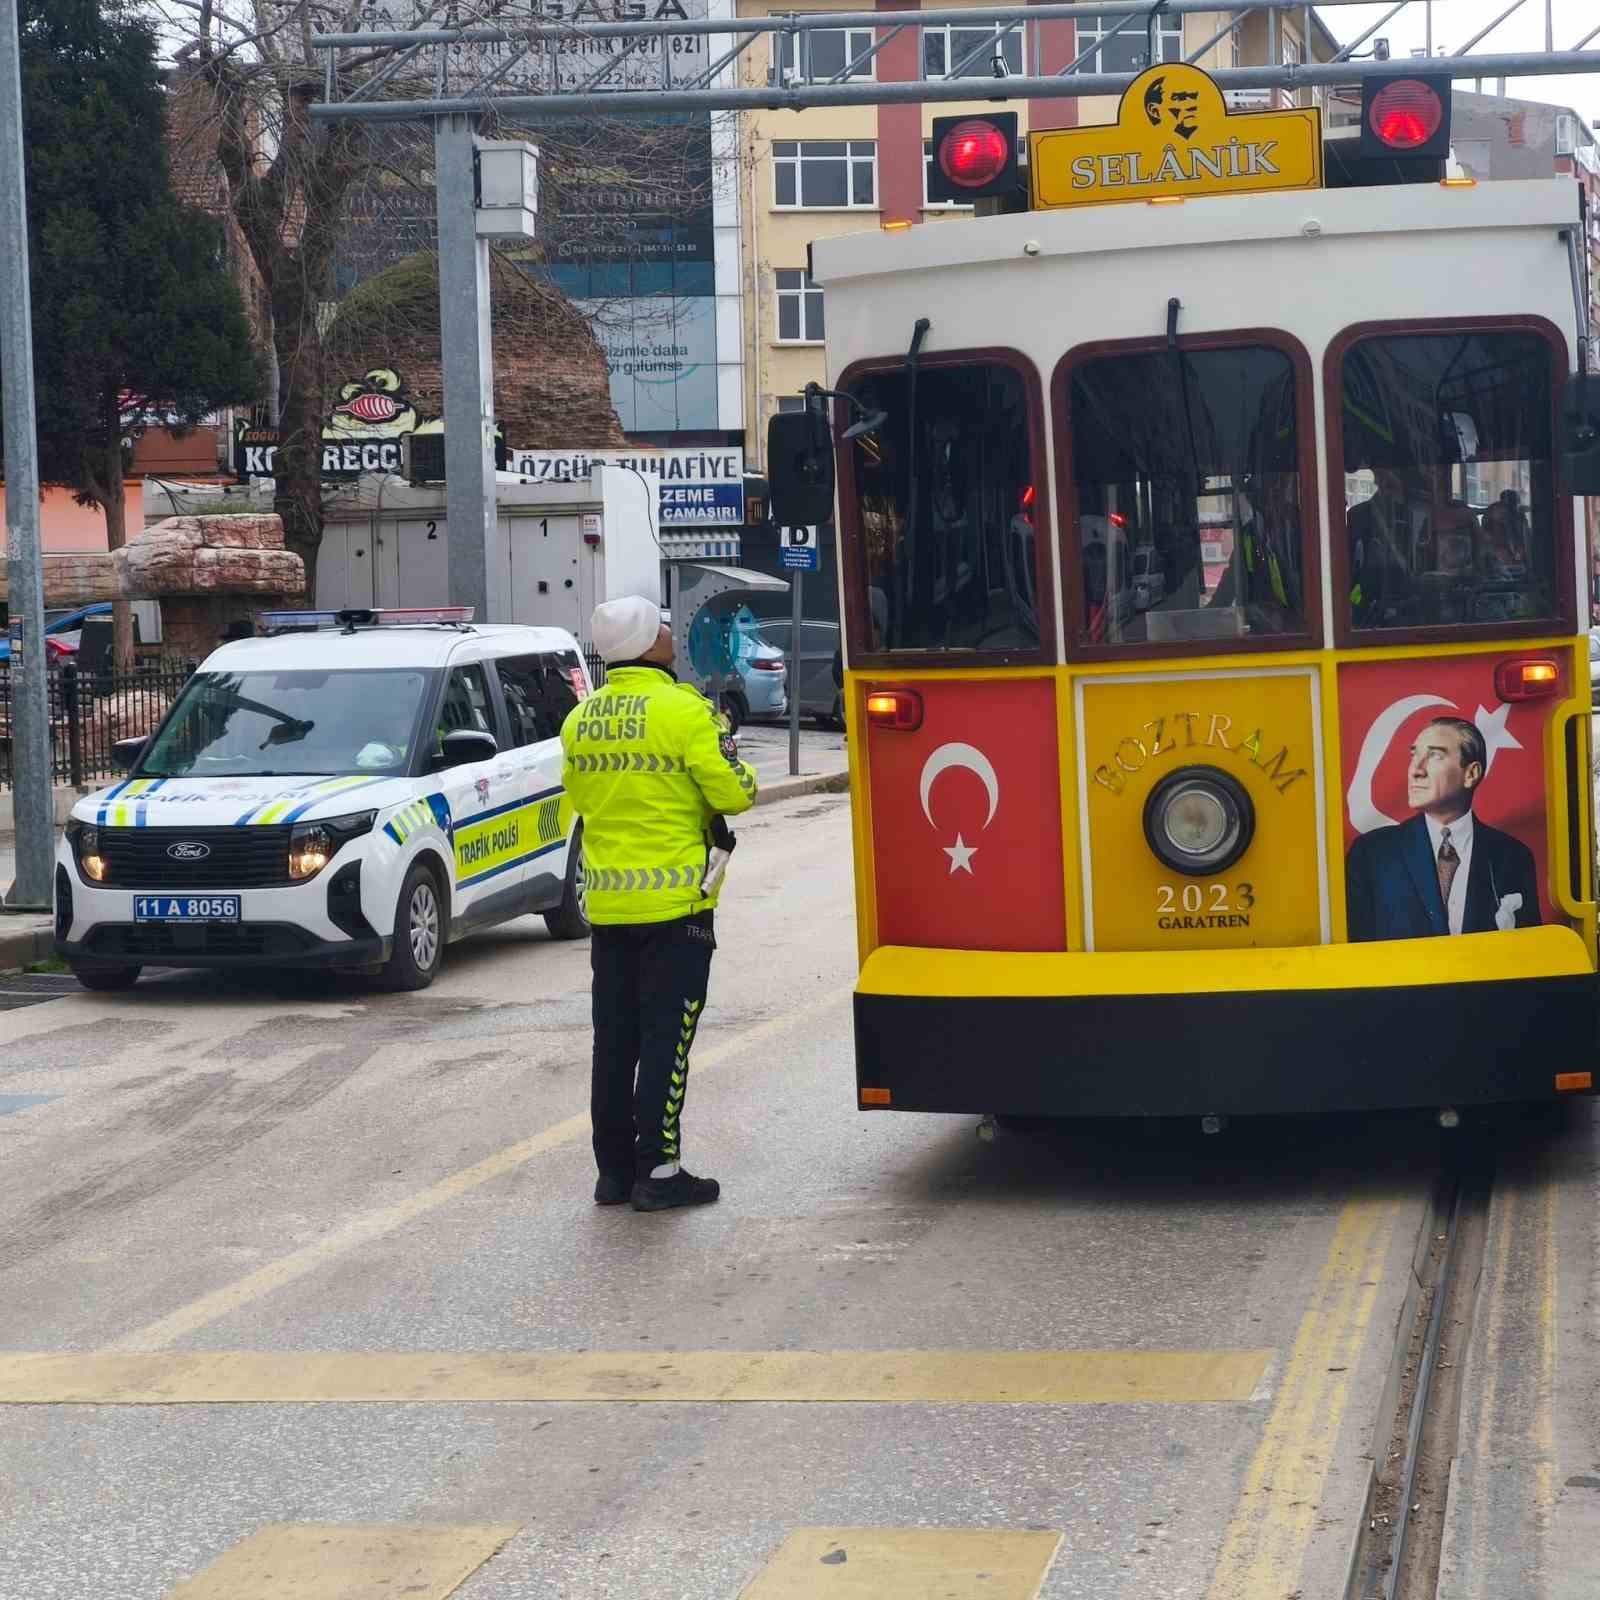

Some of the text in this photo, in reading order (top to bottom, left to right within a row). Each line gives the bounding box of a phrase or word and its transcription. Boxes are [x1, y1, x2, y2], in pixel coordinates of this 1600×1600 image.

[622, 33, 700, 53] Merezi
[1071, 136, 1280, 189] SELÂNİK
[427, 521, 437, 540] 2
[540, 518, 548, 537] 1
[1094, 712, 1308, 796] BOZTRAM
[174, 843, 202, 857] Ford
[459, 818, 520, 867] TRAFİK POLİSİ
[138, 899, 235, 916] 11 A 8056
[1157, 883, 1255, 913] 2023
[1158, 914, 1251, 930] GARATREN
